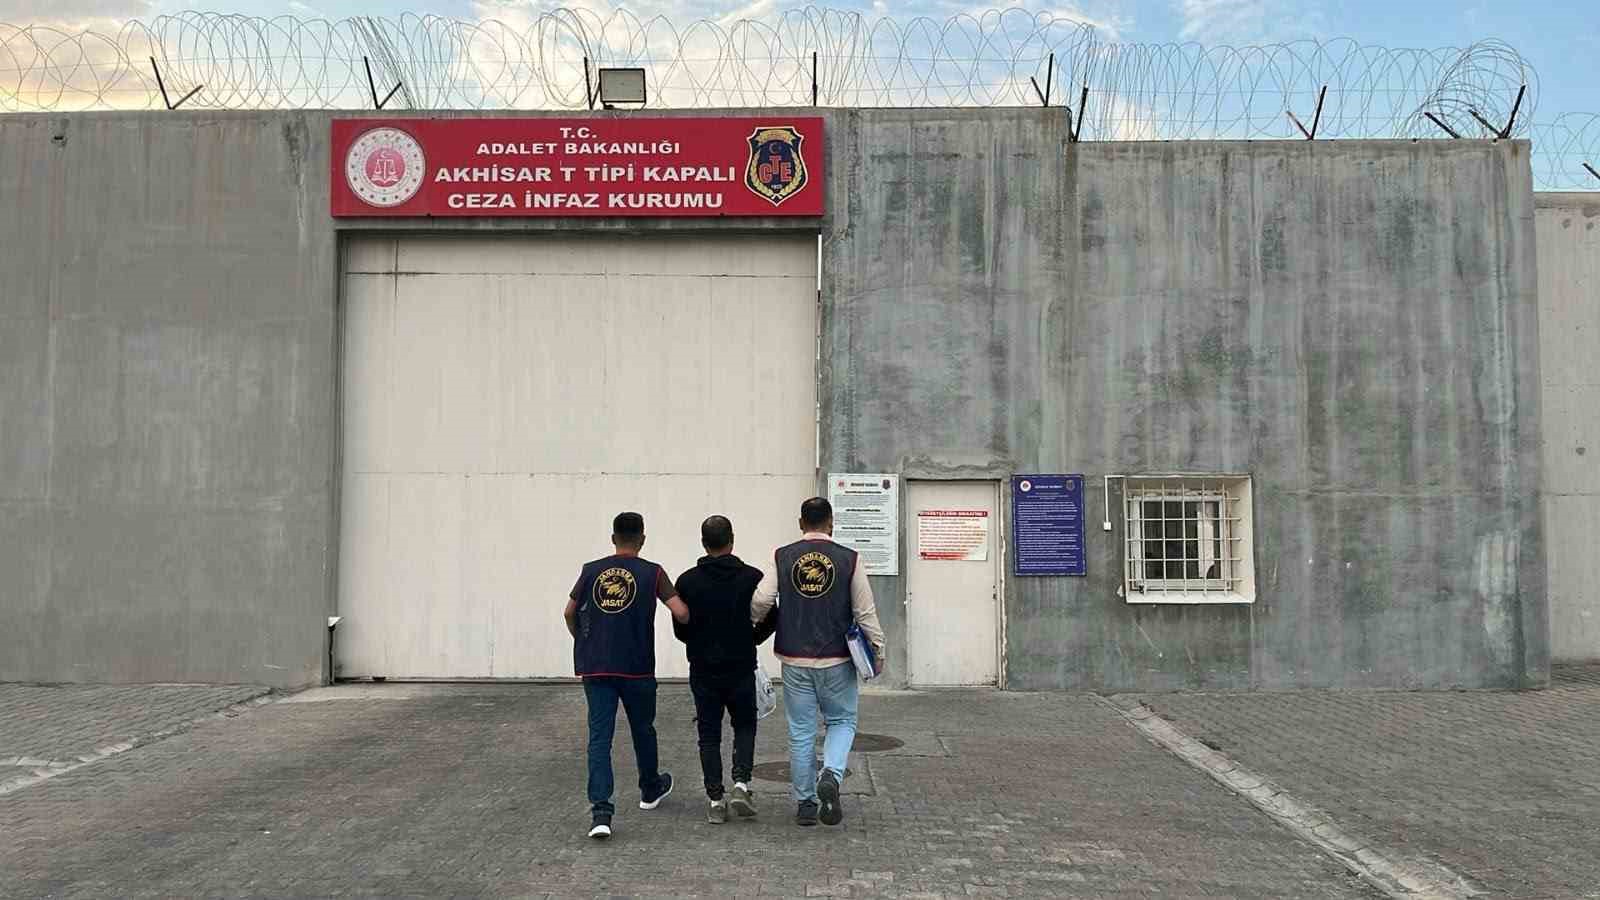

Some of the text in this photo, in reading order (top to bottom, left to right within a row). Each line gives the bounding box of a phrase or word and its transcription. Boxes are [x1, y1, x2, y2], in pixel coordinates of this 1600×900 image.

[559, 127, 596, 139] T.C.
[477, 138, 680, 155] ADALET BAKANLIĞI
[434, 164, 736, 182] AKHİSAR T TİPİ KAPALI
[447, 189, 723, 209] CEZA İNFAZ KURUMU
[798, 552, 832, 570] JANDARMA
[599, 568, 633, 584] JANDARMA
[800, 584, 824, 593] JASAT
[601, 599, 625, 608] JASAT
